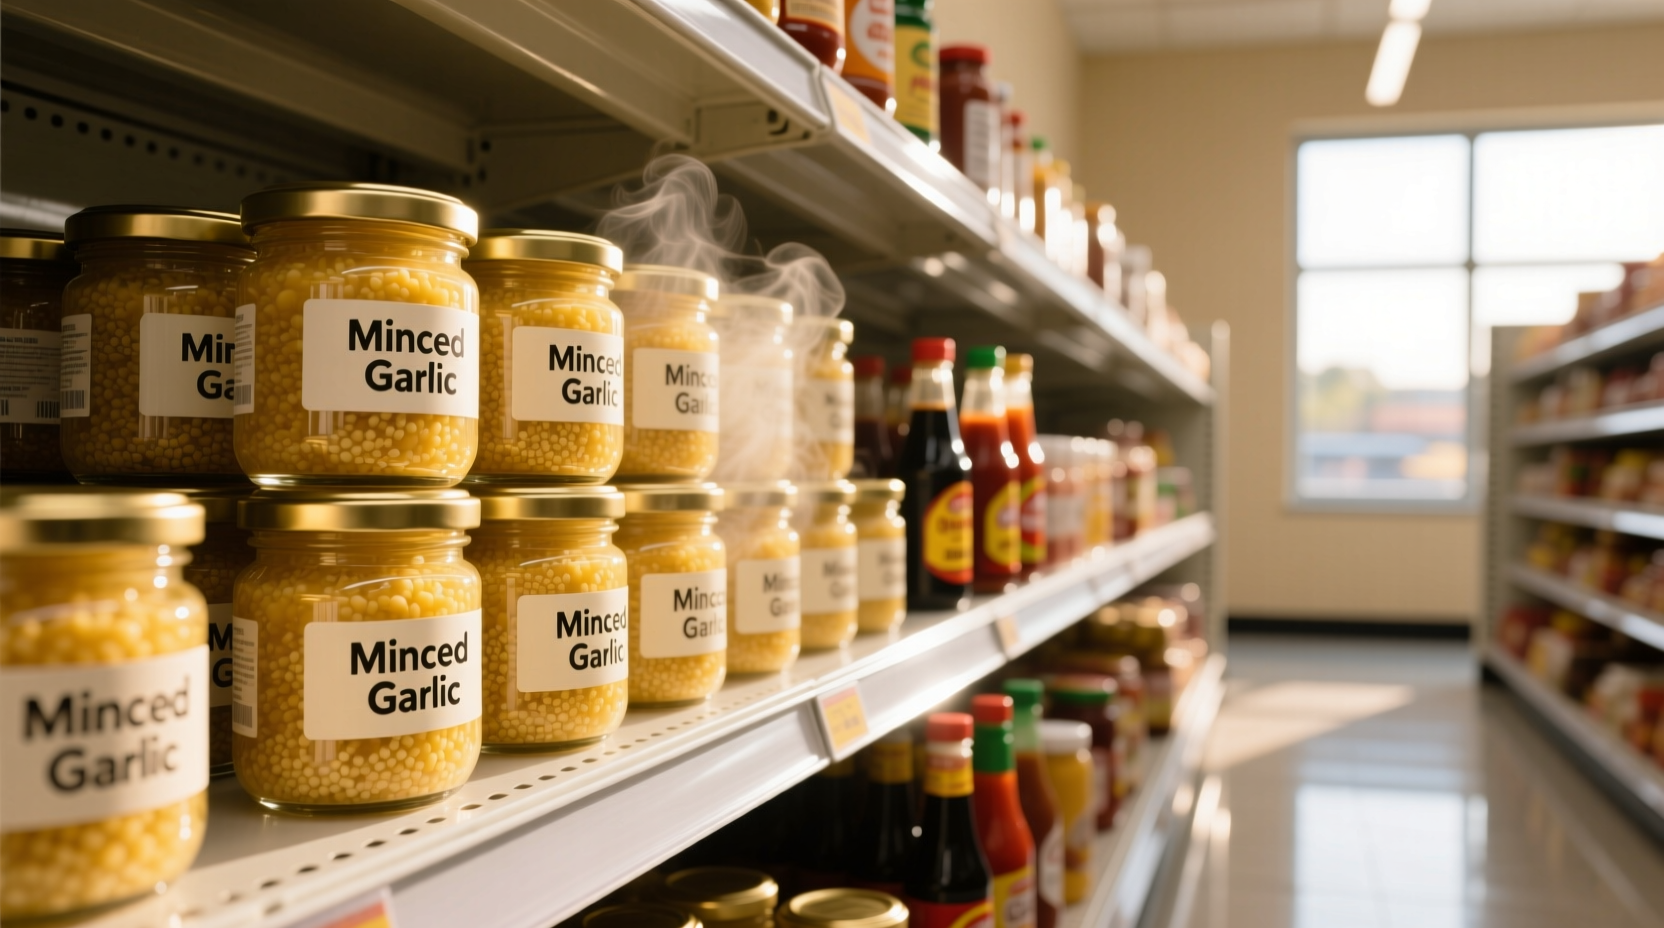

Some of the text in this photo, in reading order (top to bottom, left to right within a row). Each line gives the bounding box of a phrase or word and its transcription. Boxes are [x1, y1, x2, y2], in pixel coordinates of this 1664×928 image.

[349, 319, 464, 358] Minced
[365, 359, 457, 395] Garlic
[548, 344, 622, 377] Minced
[561, 378, 618, 407] Garlic
[557, 604, 627, 639] Minced
[351, 631, 468, 675] Minced
[569, 639, 624, 670] Garlic
[23, 675, 191, 740] Minced
[368, 675, 461, 715] Garlic
[47, 735, 179, 792] Garlic
